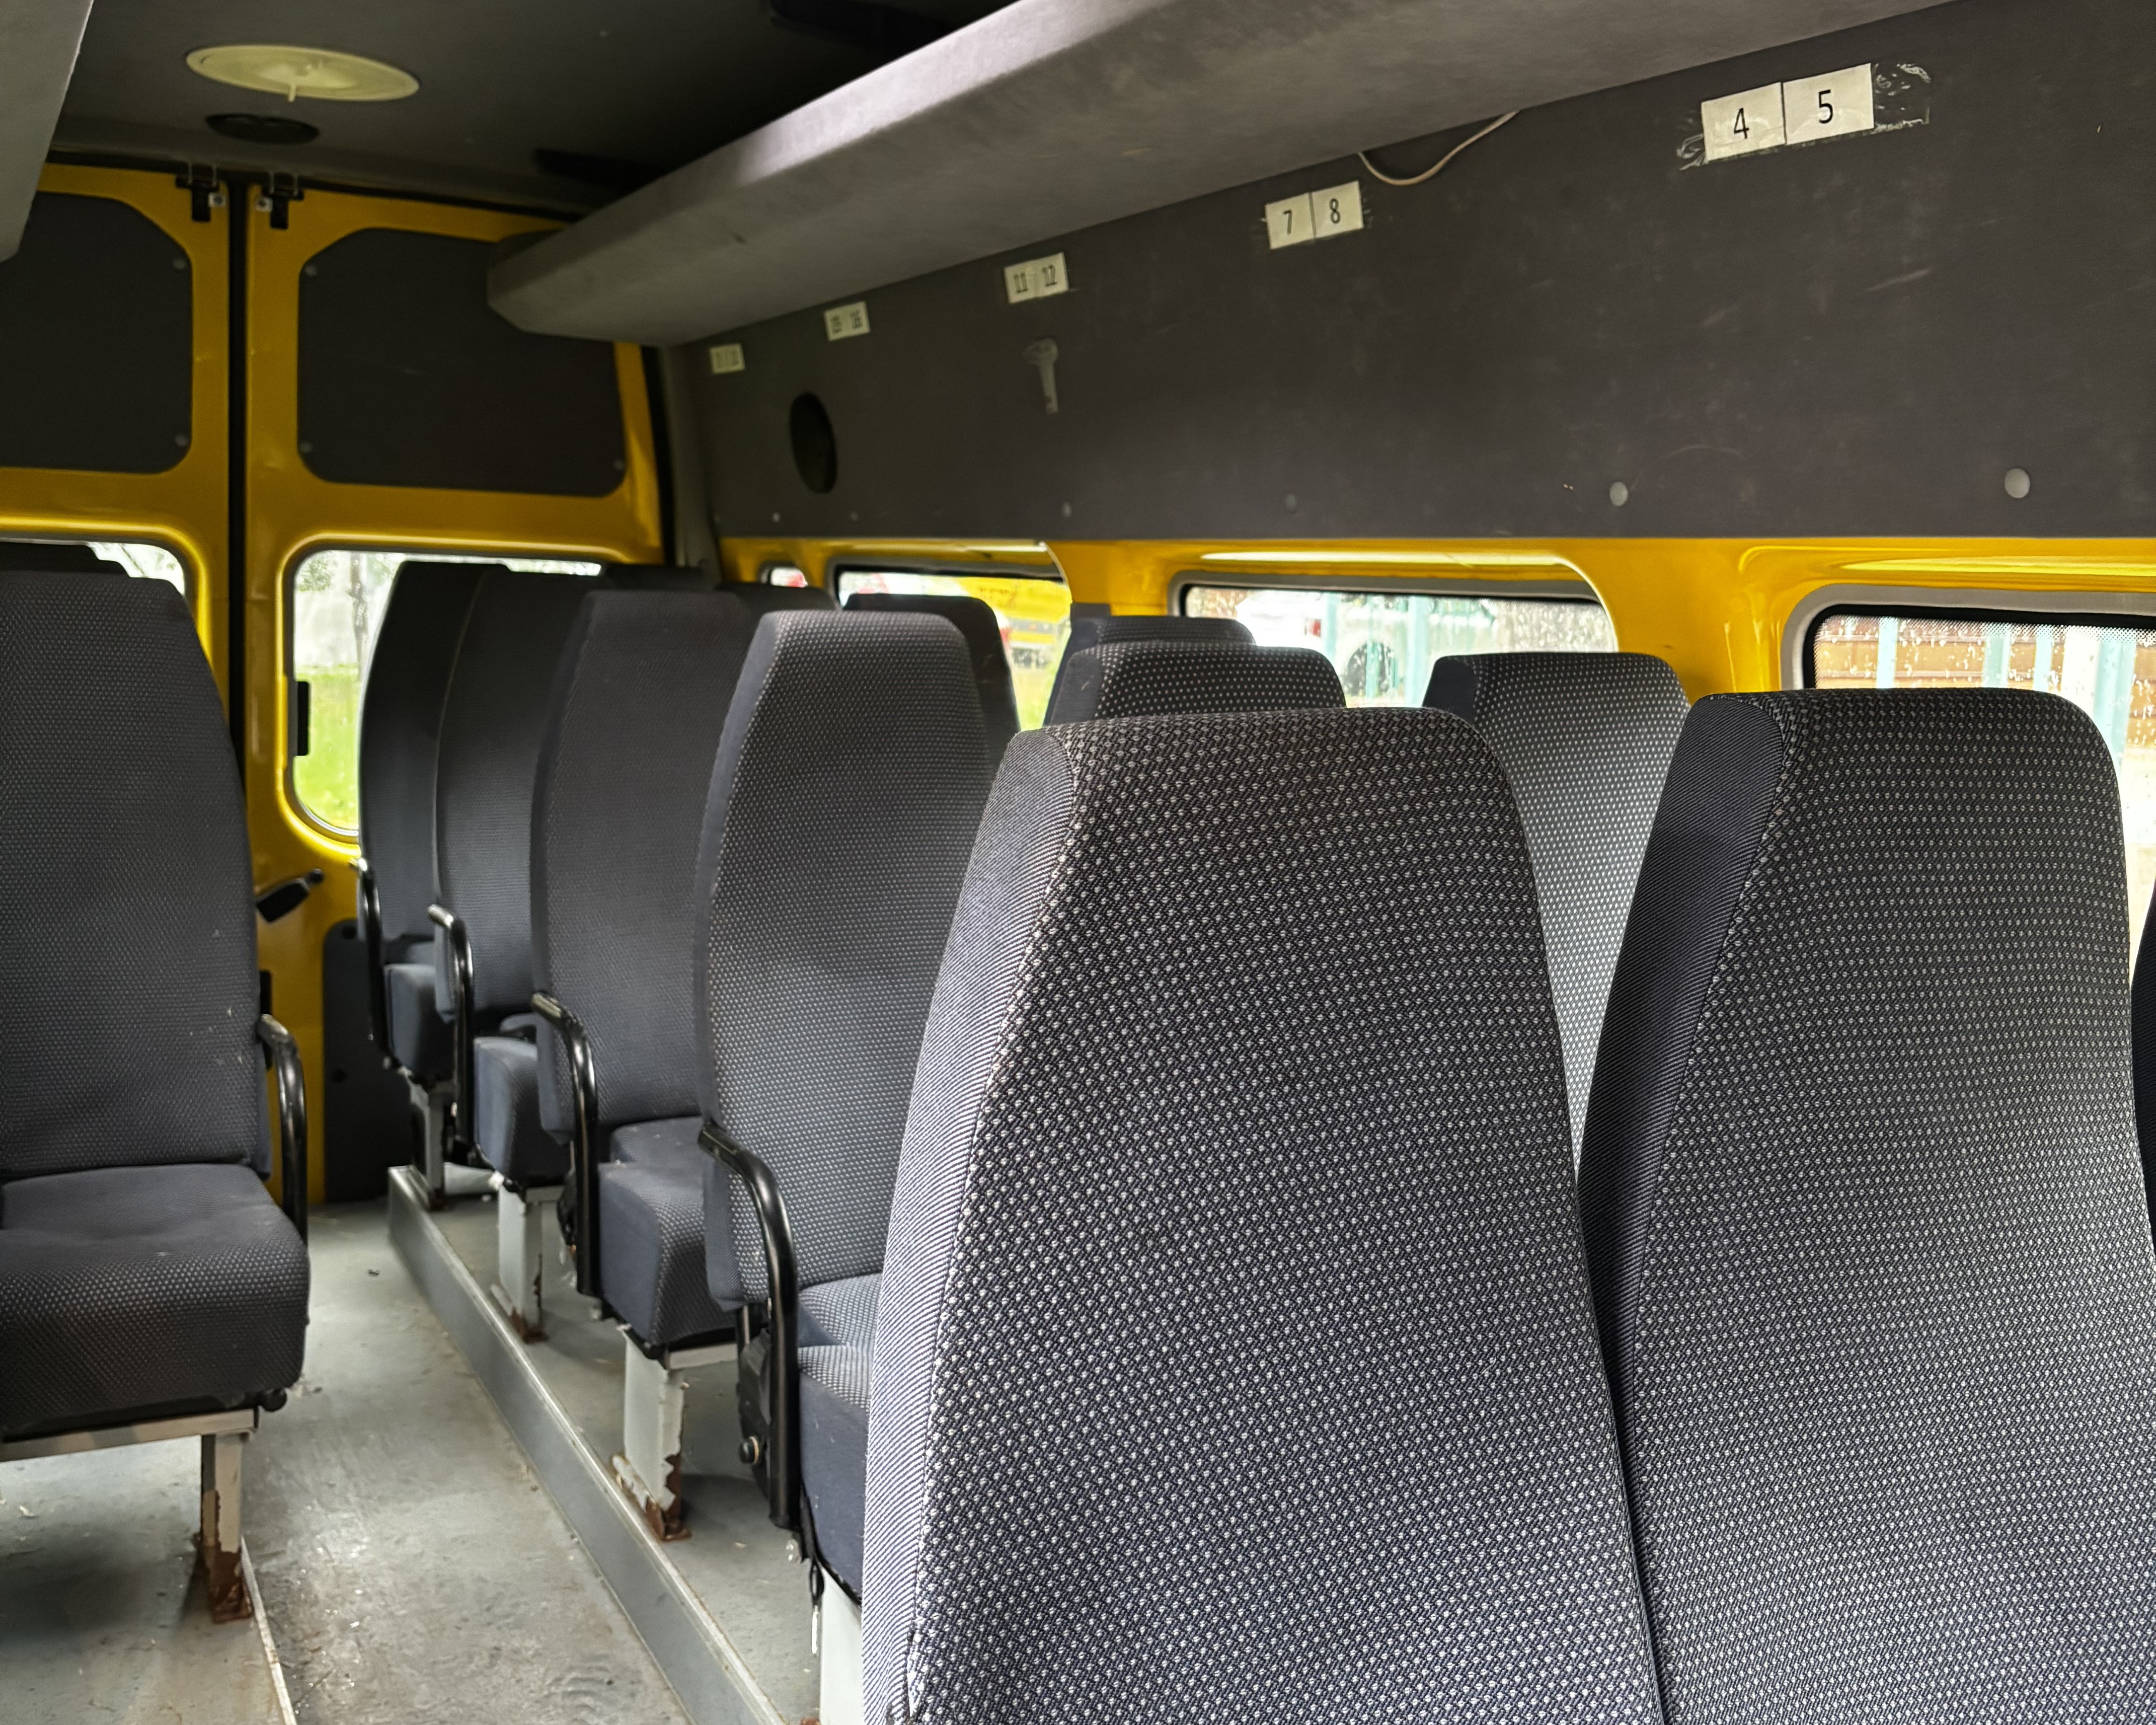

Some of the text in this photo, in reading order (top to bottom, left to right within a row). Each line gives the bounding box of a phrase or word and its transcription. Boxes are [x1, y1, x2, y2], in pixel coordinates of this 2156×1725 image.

[1733, 89, 1833, 139] 4 5
[1283, 198, 1341, 235] 7 8
[1014, 272, 1028, 293] 11
